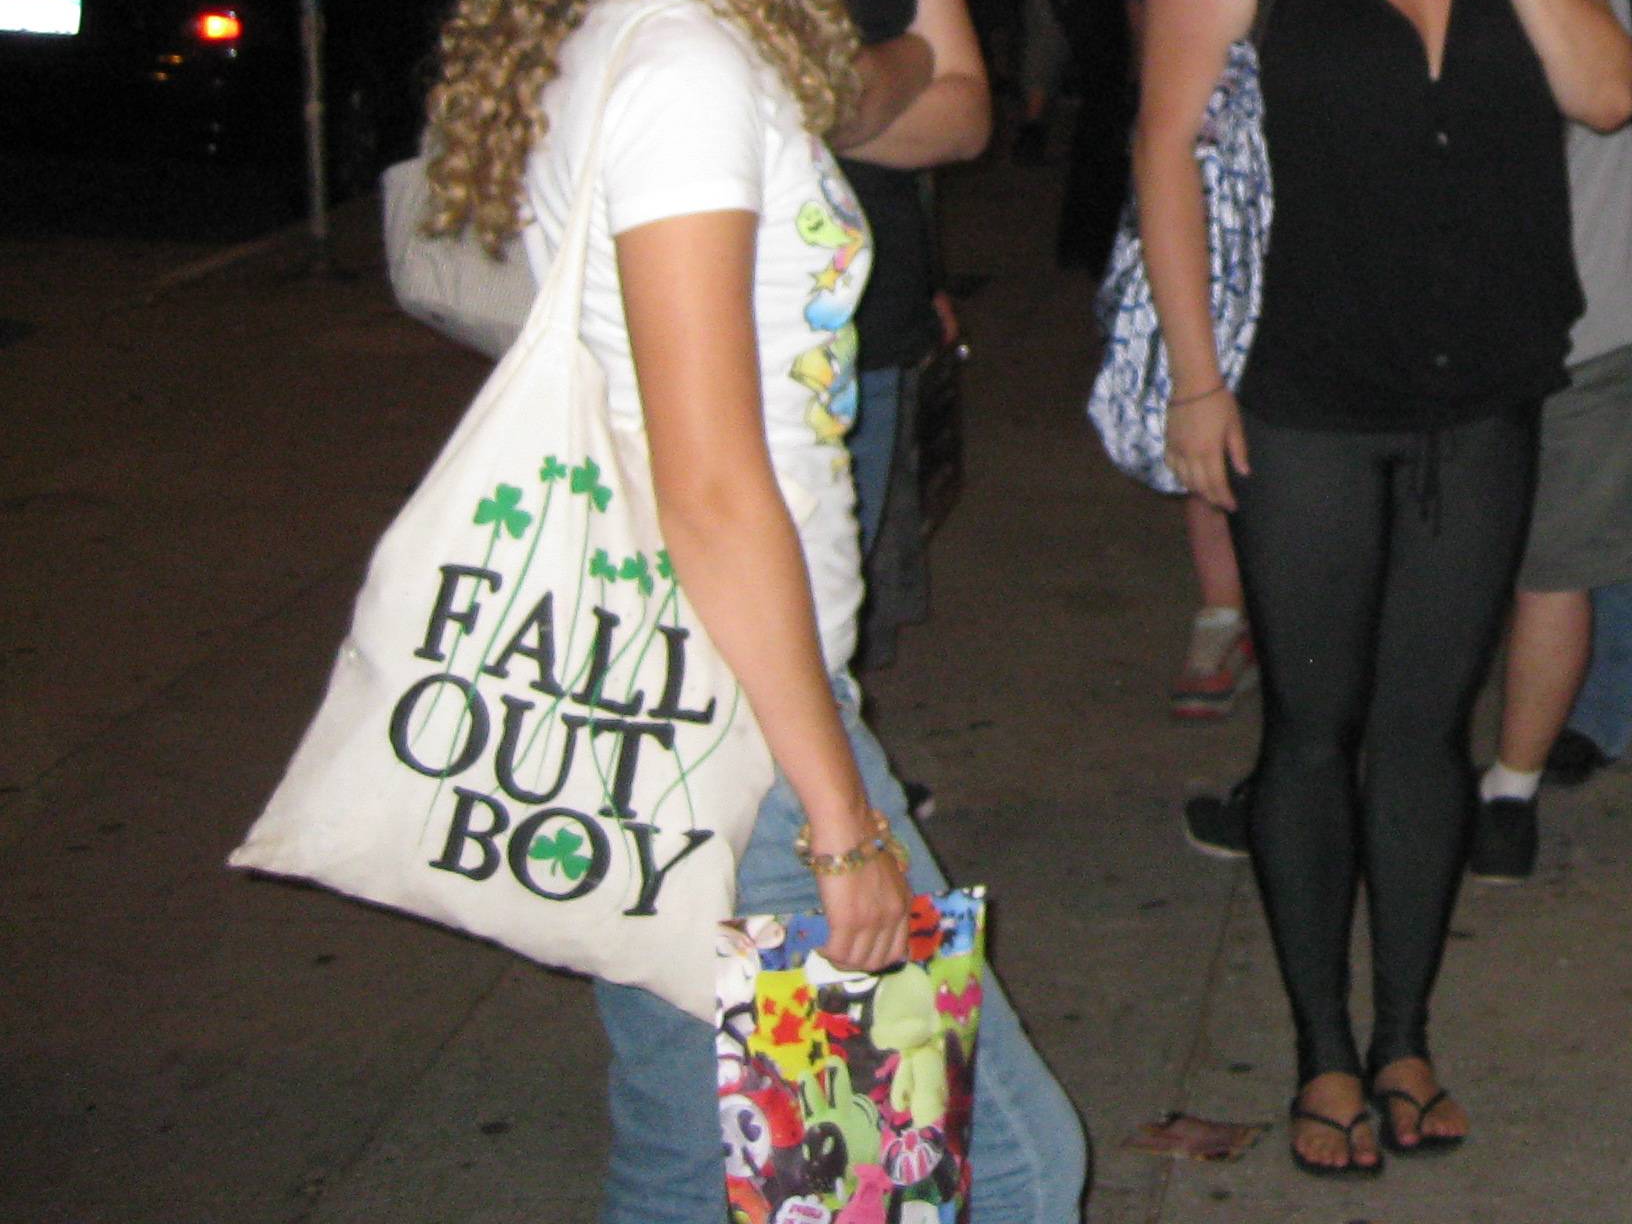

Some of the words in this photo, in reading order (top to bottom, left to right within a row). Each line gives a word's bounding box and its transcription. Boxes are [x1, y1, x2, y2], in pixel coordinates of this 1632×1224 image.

[414, 563, 716, 725] FALL
[388, 672, 676, 819] OUT
[428, 786, 715, 917] BOY
